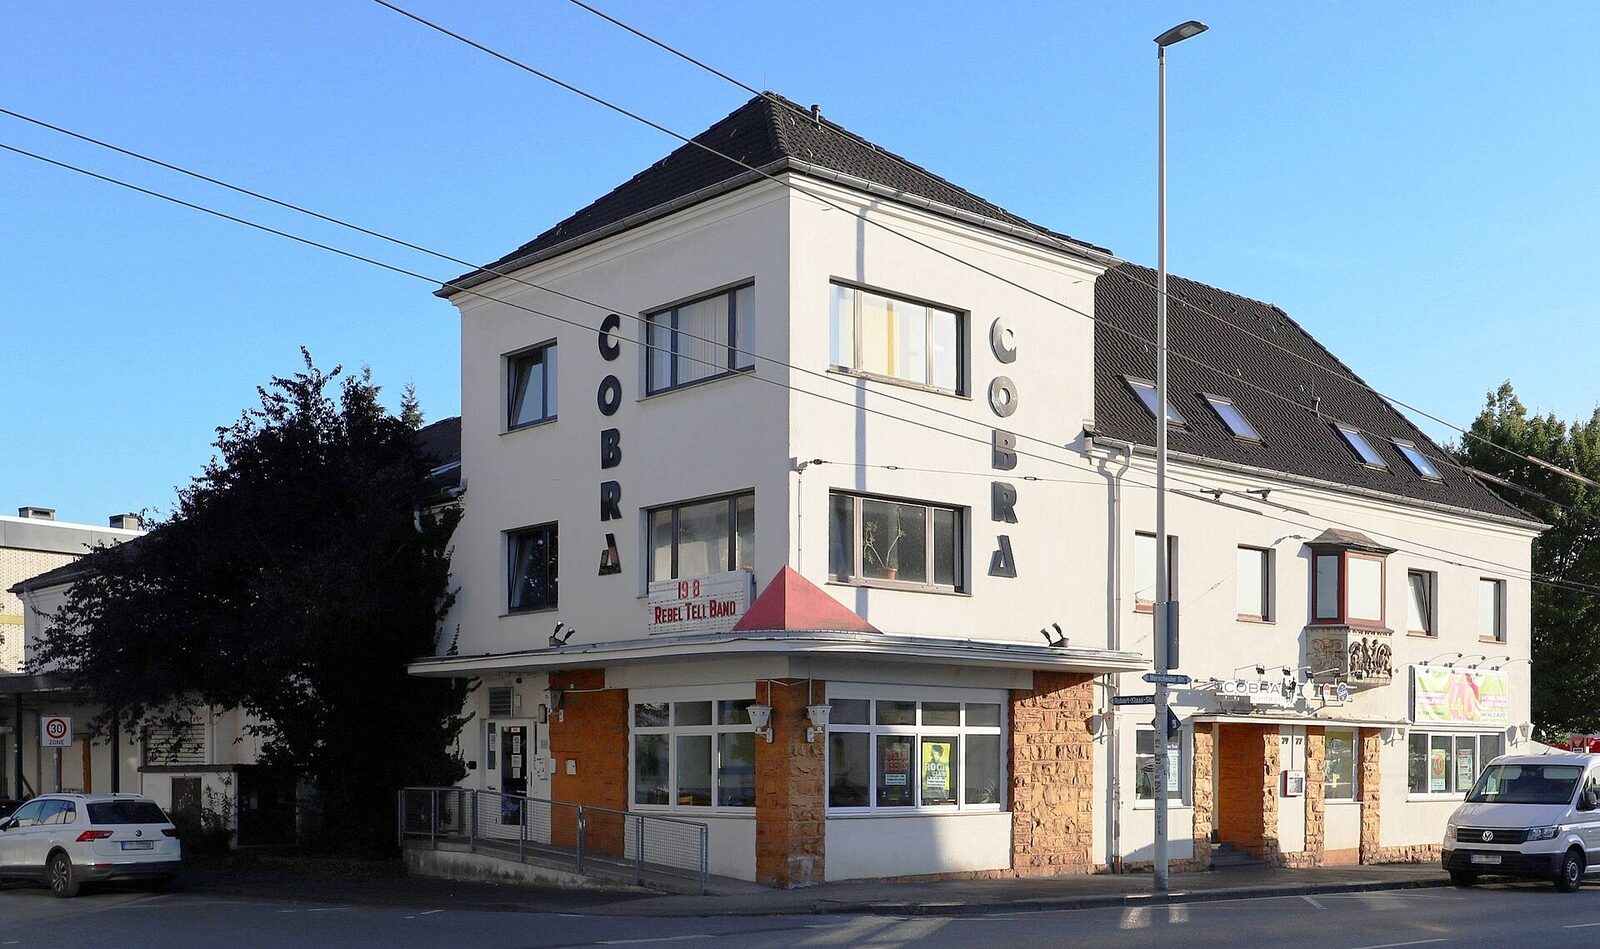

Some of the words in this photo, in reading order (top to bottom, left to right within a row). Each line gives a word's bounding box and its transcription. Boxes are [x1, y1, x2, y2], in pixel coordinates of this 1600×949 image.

[597, 313, 622, 576] COBRA
[987, 316, 1019, 578] COBRA
[654, 606, 683, 625] REBEL
[685, 602, 707, 620] TELL
[709, 600, 736, 618] BAND
[1224, 682, 1280, 694] COBRA
[51, 724, 62, 733] 30
